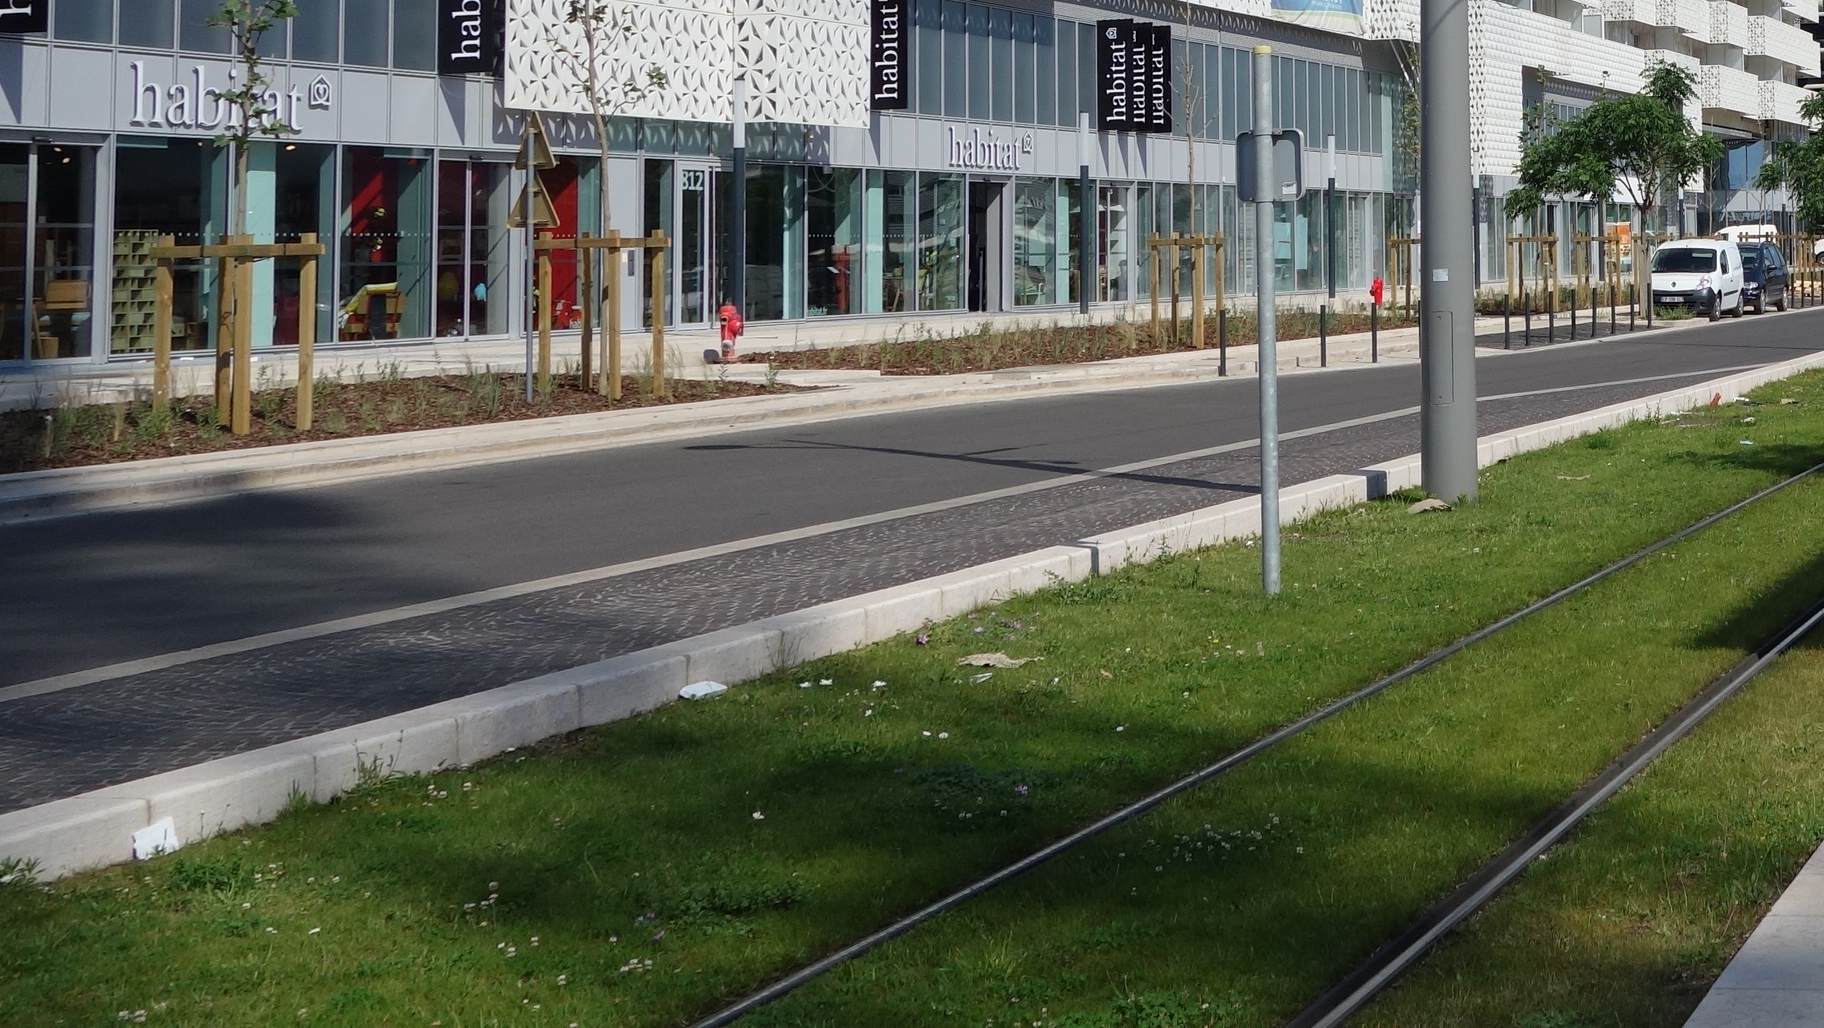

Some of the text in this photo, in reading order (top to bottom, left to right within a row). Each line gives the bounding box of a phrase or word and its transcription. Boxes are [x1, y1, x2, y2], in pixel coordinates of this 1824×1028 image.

[875, 3, 899, 100] habitat
[1106, 40, 1127, 122] habitat
[949, 125, 1021, 169] habitat
[681, 171, 704, 190] 812
